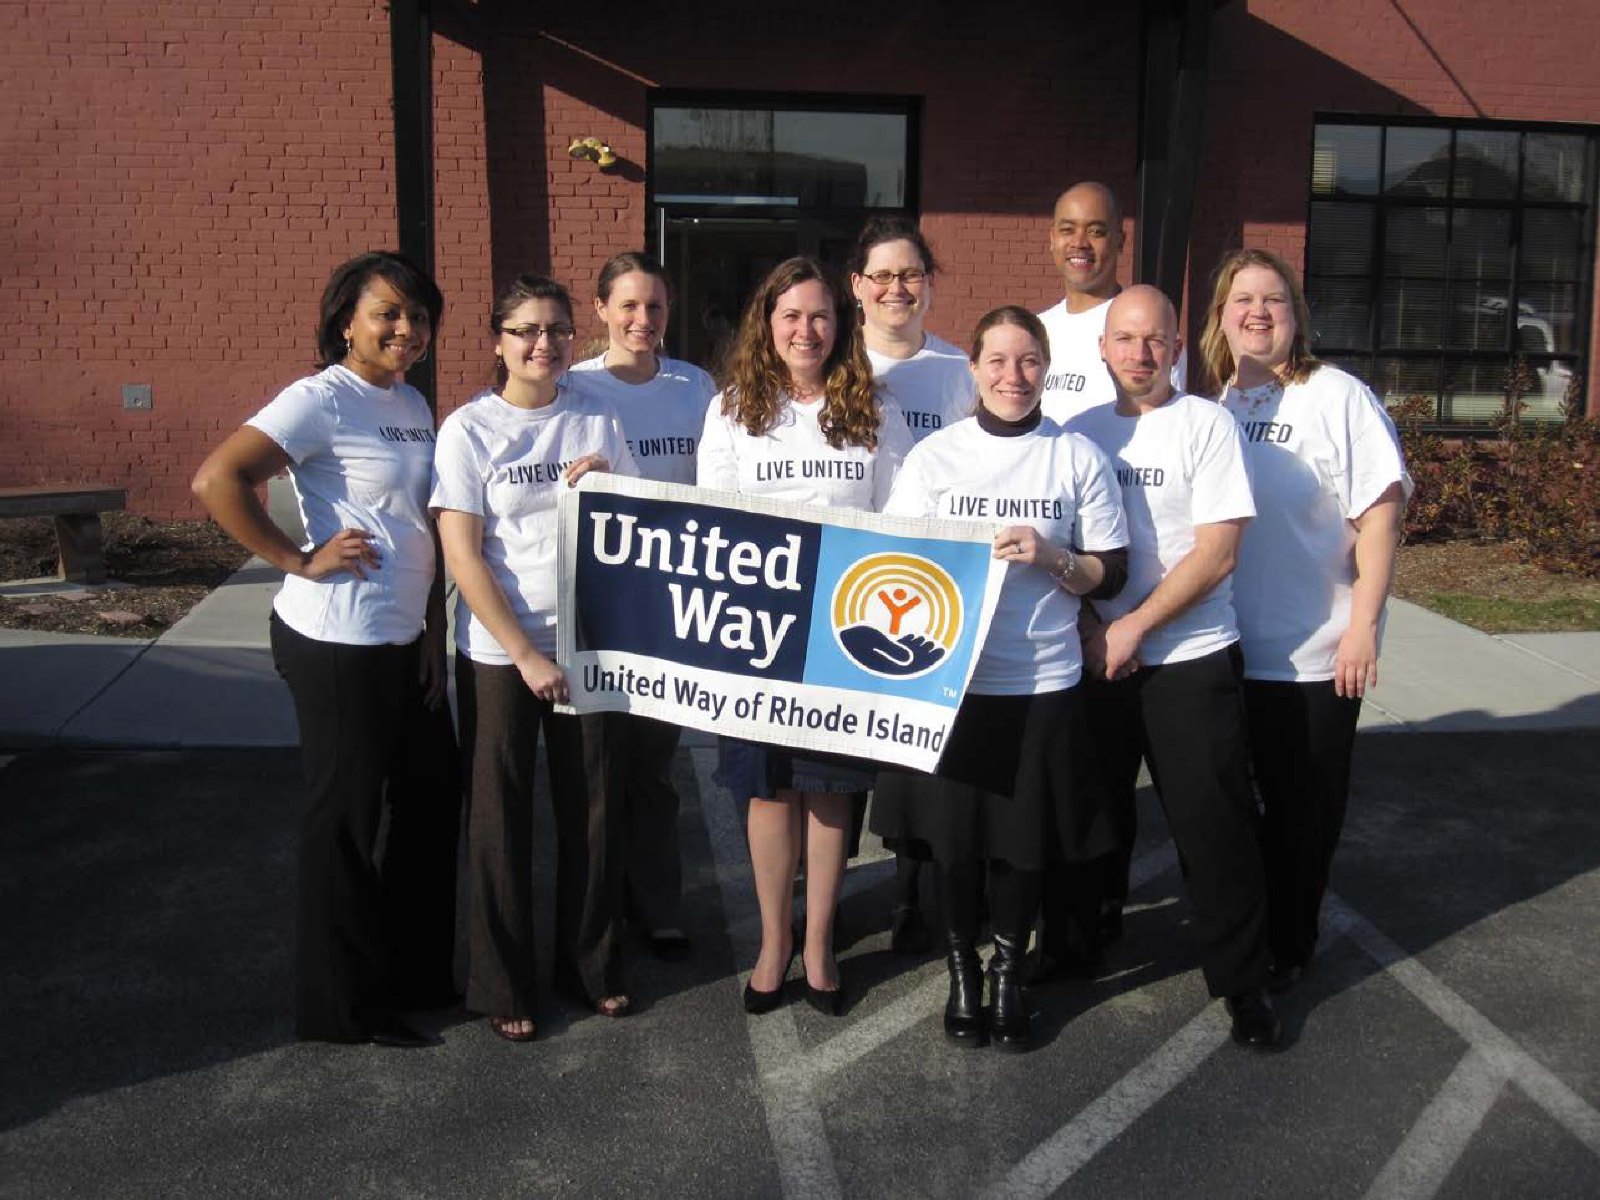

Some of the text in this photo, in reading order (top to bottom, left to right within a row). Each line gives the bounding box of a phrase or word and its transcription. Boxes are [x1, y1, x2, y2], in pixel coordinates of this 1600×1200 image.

[902, 410, 942, 429] ITED
[379, 426, 407, 442] LIVE
[639, 437, 695, 457] UNITED
[508, 463, 543, 484] LIVE
[756, 460, 864, 481] LIVE UNITED
[949, 495, 1062, 520] LIVE UNITED
[589, 512, 802, 591] United
[668, 583, 797, 669] Way
[583, 664, 946, 753] United Way of Rhode Island
